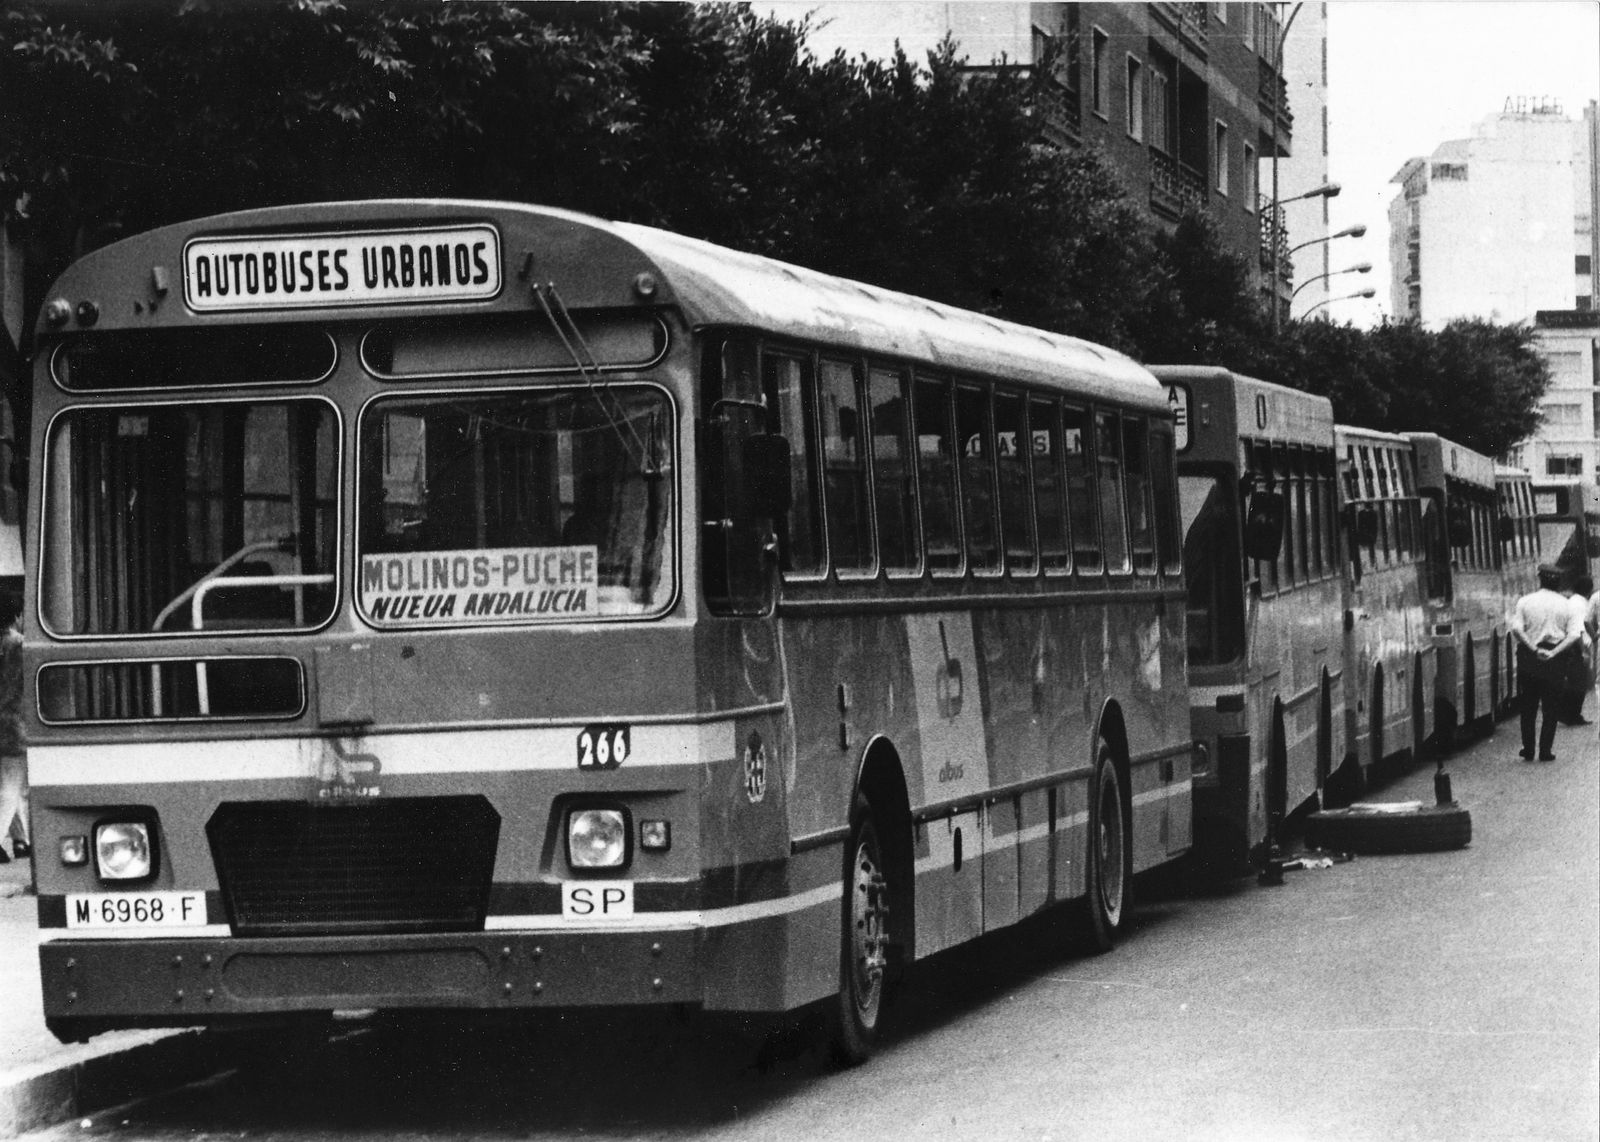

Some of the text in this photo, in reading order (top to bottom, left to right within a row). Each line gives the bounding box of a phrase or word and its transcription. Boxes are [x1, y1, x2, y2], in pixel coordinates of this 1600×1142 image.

[196, 242, 489, 297] AUTOBUSES URBANOS
[364, 551, 595, 592] MOLINOS-PUCHE
[371, 589, 587, 620] NUEVA ANDALUCIA
[580, 730, 626, 765] 266
[570, 887, 626, 915] SP
